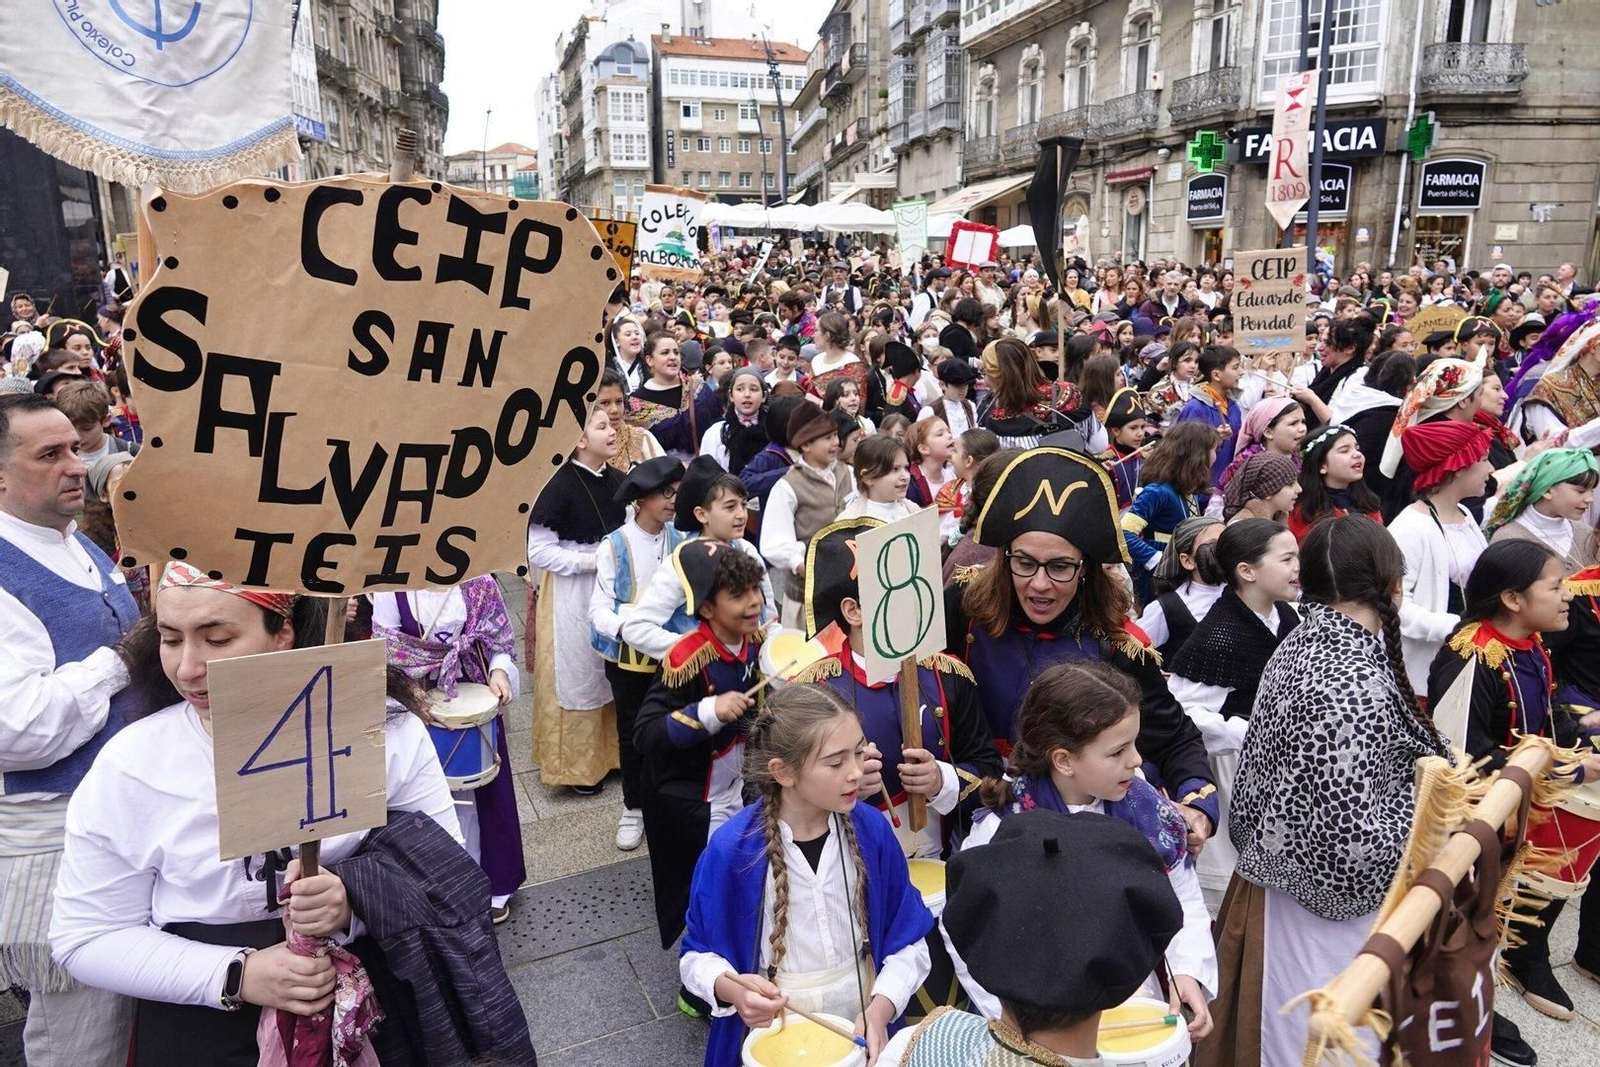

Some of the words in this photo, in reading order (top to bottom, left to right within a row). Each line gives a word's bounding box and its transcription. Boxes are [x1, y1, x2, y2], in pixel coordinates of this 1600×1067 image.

[81, 21, 135, 66] Colexio
[1245, 126, 1377, 157] FAACIA
[1273, 138, 1303, 180] R
[1189, 187, 1222, 200] FARMACIA
[1270, 182, 1307, 202] 1809
[1319, 178, 1345, 191] ACIA
[1424, 173, 1480, 186] FARMACIA
[1427, 189, 1448, 197] Puerta
[1449, 189, 1458, 197] del
[641, 203, 697, 238] COLEXIO
[301, 184, 562, 310] CEIP
[1251, 257, 1297, 281] CEIP
[1236, 288, 1304, 308] Eduardo
[1240, 313, 1296, 331] Pondal
[347, 309, 508, 388] SAN
[133, 285, 602, 530] SALVADOR
[1013, 479, 1089, 521] N
[235, 526, 478, 593] TEIS
[872, 532, 935, 659] 8
[237, 665, 352, 829] 4
